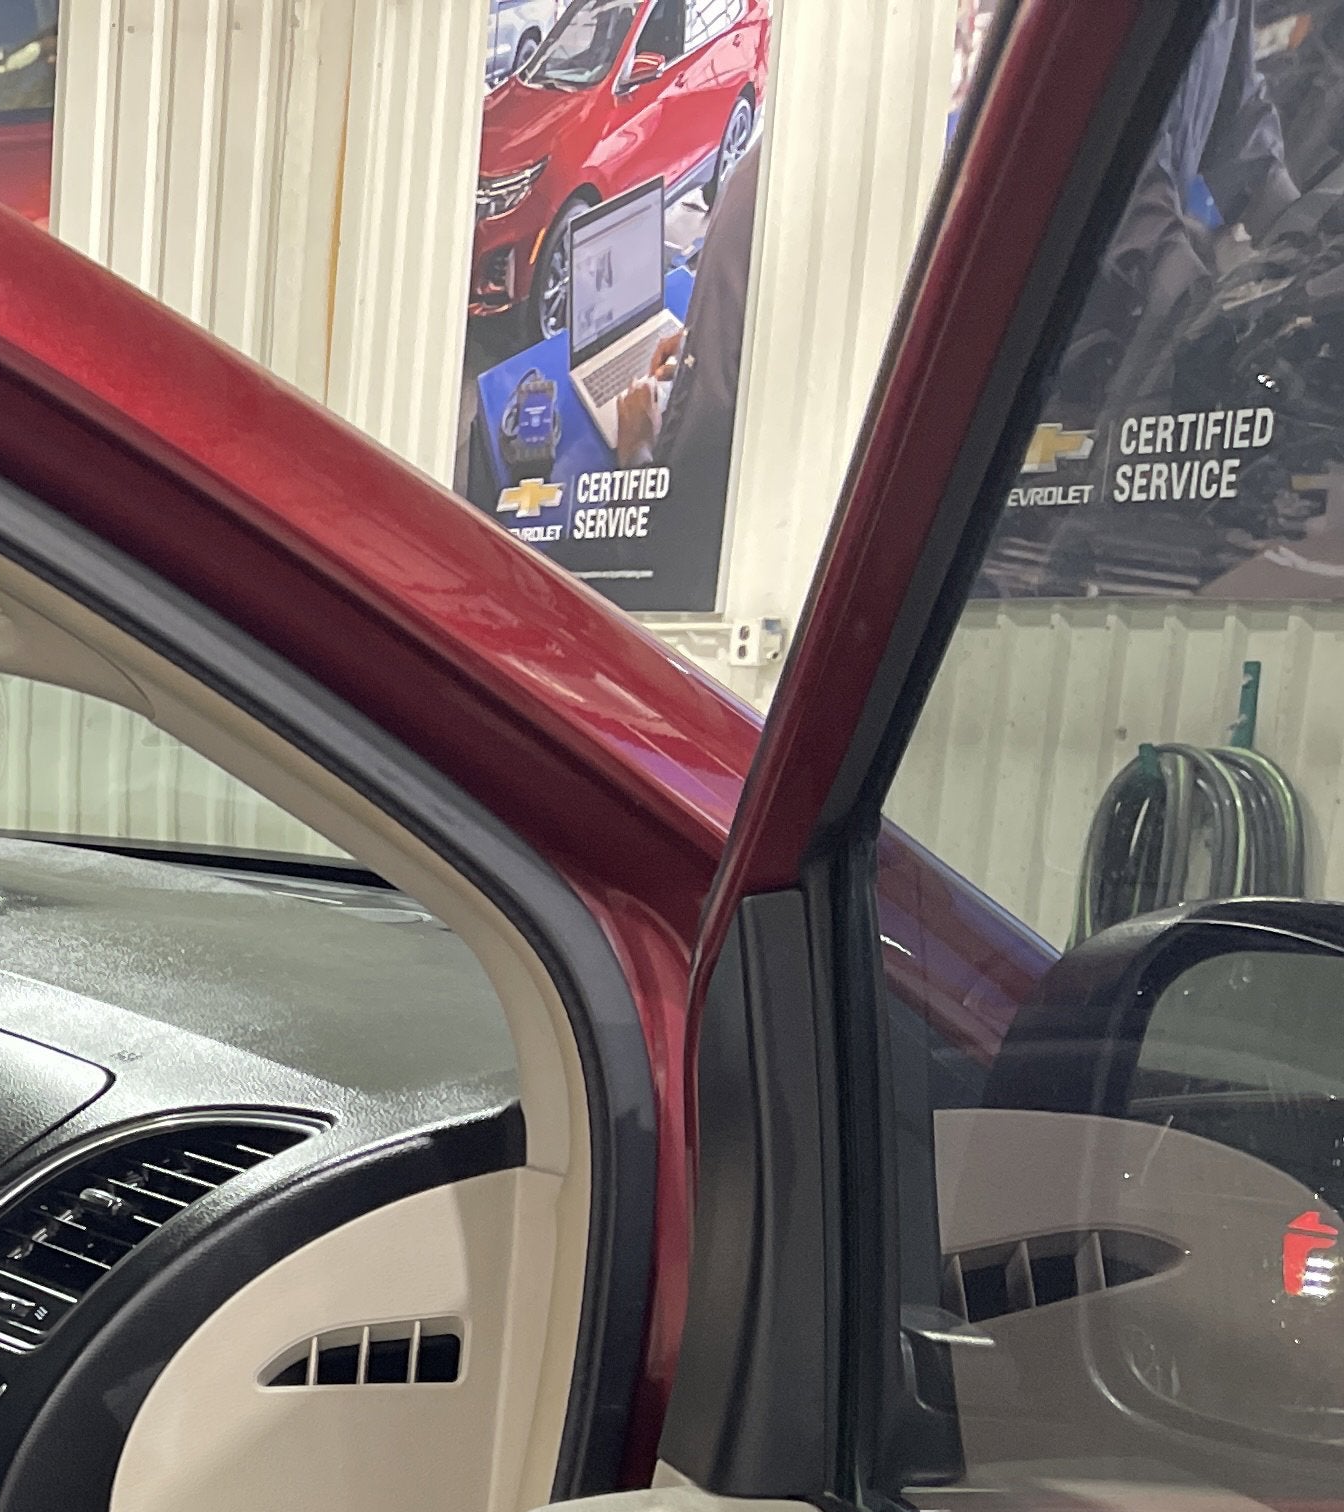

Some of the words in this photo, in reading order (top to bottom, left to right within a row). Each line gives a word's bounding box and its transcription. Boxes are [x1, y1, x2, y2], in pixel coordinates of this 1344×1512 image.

[1120, 407, 1275, 455] CERTIFIED
[577, 467, 670, 503] CERTIFIED
[1007, 485, 1094, 507] EVROLET
[1113, 459, 1240, 502] SERVICE
[573, 506, 650, 540] SERVICE
